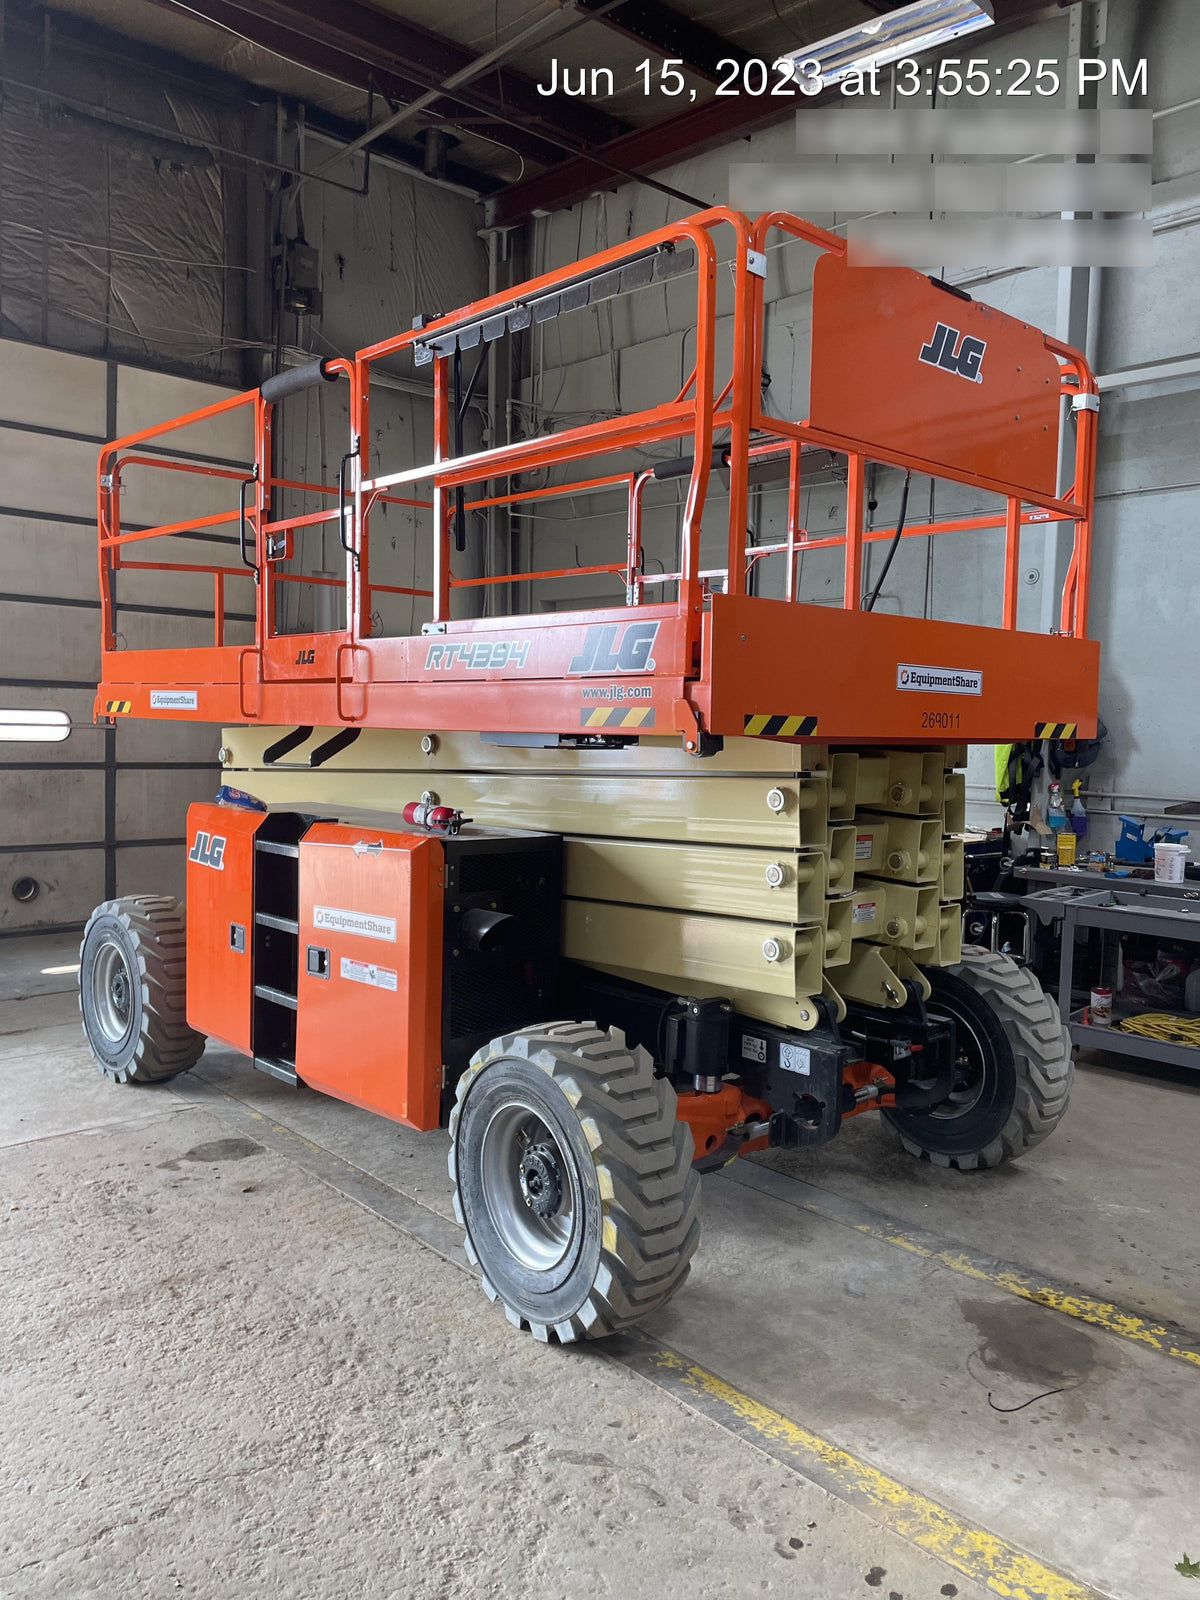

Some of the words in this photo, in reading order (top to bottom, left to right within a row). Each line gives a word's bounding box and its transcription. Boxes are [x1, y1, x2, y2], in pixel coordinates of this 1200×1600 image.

[918, 321, 988, 384] JLG
[295, 649, 316, 665] JLG
[423, 640, 532, 671] RT4394
[567, 621, 662, 674] JLG
[910, 671, 979, 689] EquipmentShare
[156, 694, 195, 706] EquipmentShare
[581, 684, 652, 701] www.jlg.com
[921, 711, 961, 729] 269011
[188, 830, 227, 871] JLG
[324, 912, 392, 936] EquipmentShare
